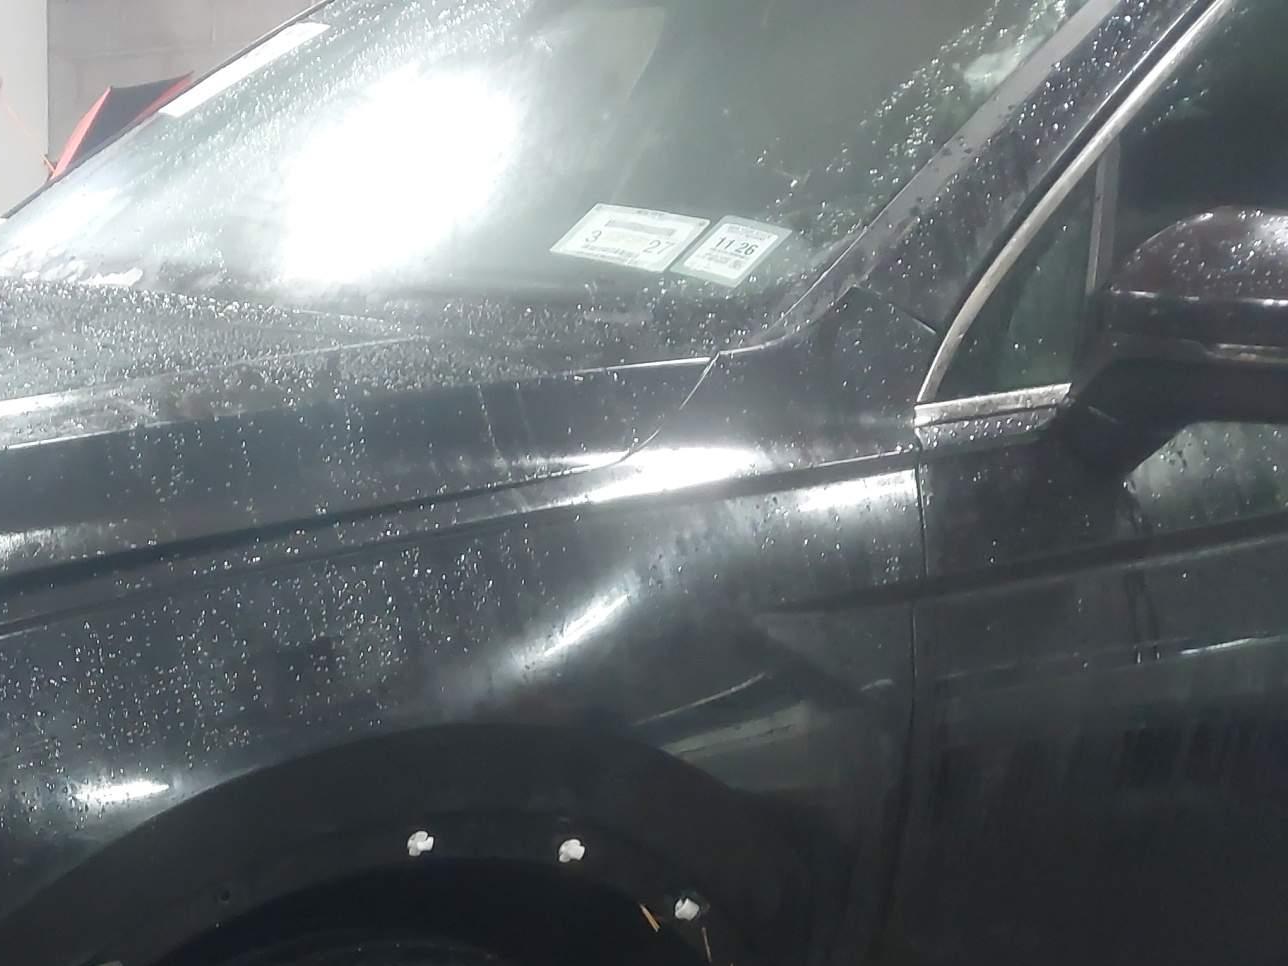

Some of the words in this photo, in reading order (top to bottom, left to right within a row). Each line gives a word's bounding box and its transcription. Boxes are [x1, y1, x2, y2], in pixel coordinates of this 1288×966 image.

[643, 239, 675, 255] 27
[715, 236, 734, 250] 11
[735, 241, 757, 256] 26
